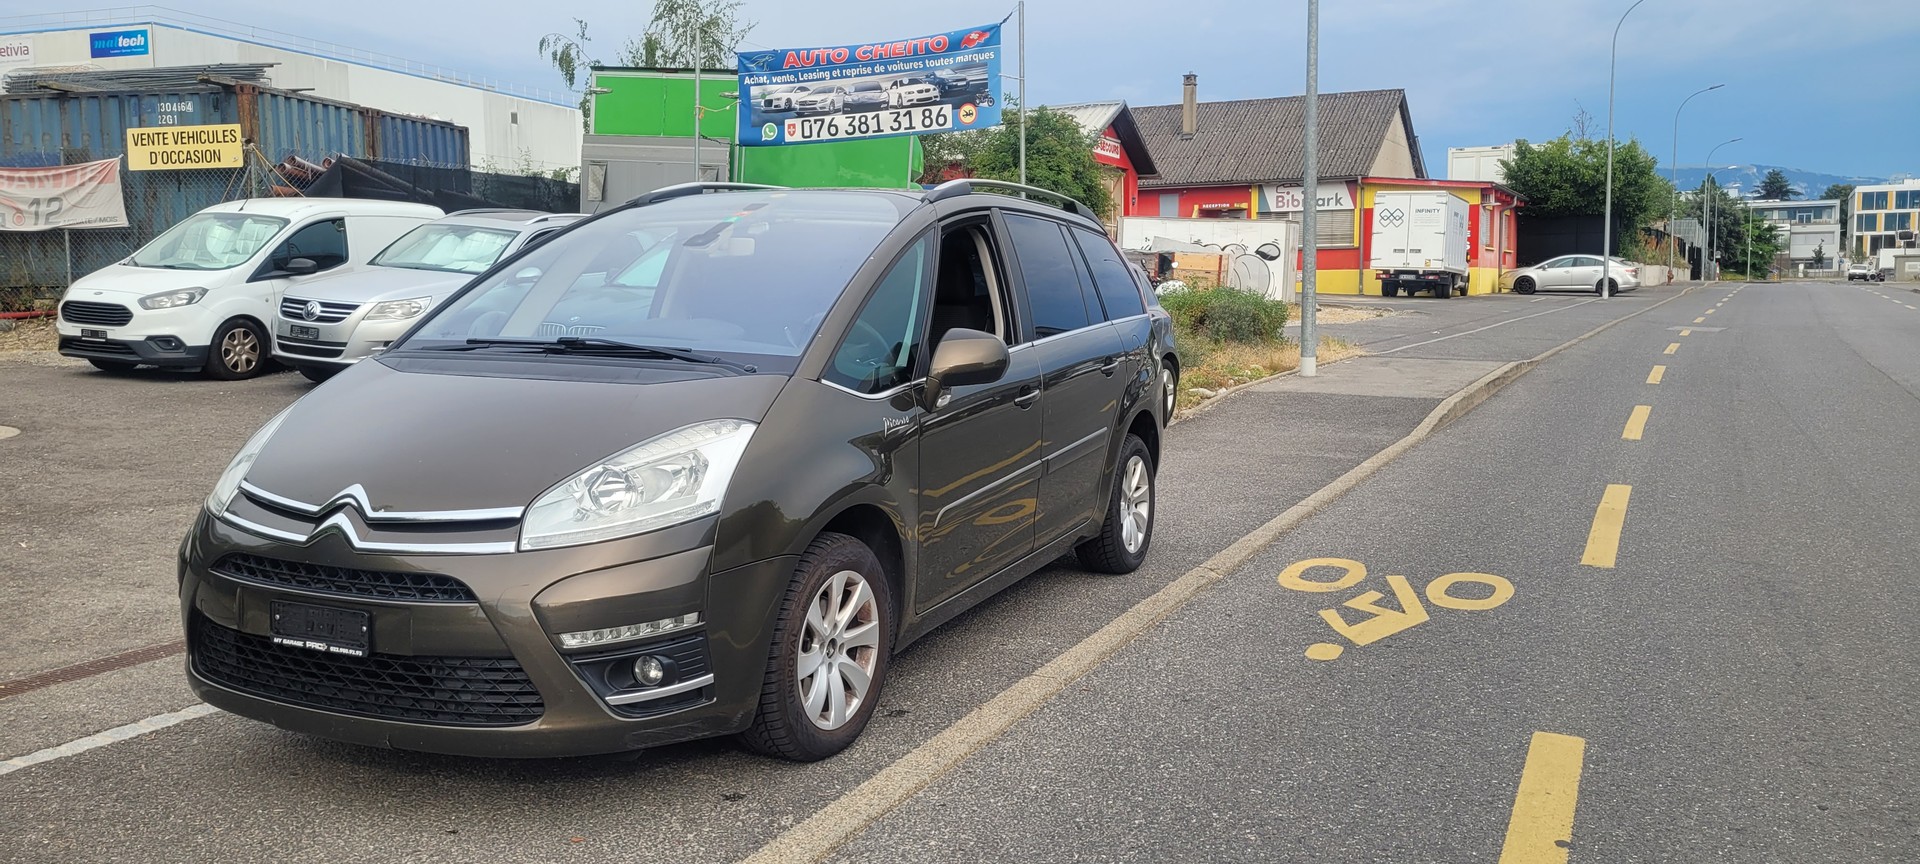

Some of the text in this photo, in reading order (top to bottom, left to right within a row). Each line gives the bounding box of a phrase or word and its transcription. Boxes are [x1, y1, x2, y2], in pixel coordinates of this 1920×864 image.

[94, 34, 145, 49] maltech
[783, 35, 949, 69] AUTO CHEITO
[744, 51, 995, 85] Achat, vente, Leasing et reprise de voitures toutes marques
[801, 107, 948, 139] 076 381 31 86
[132, 129, 237, 146] VENTE VEHICULES
[150, 149, 221, 165] D'OCCASION
[28, 196, 63, 226] 12
[1276, 190, 1343, 209] Bibark
